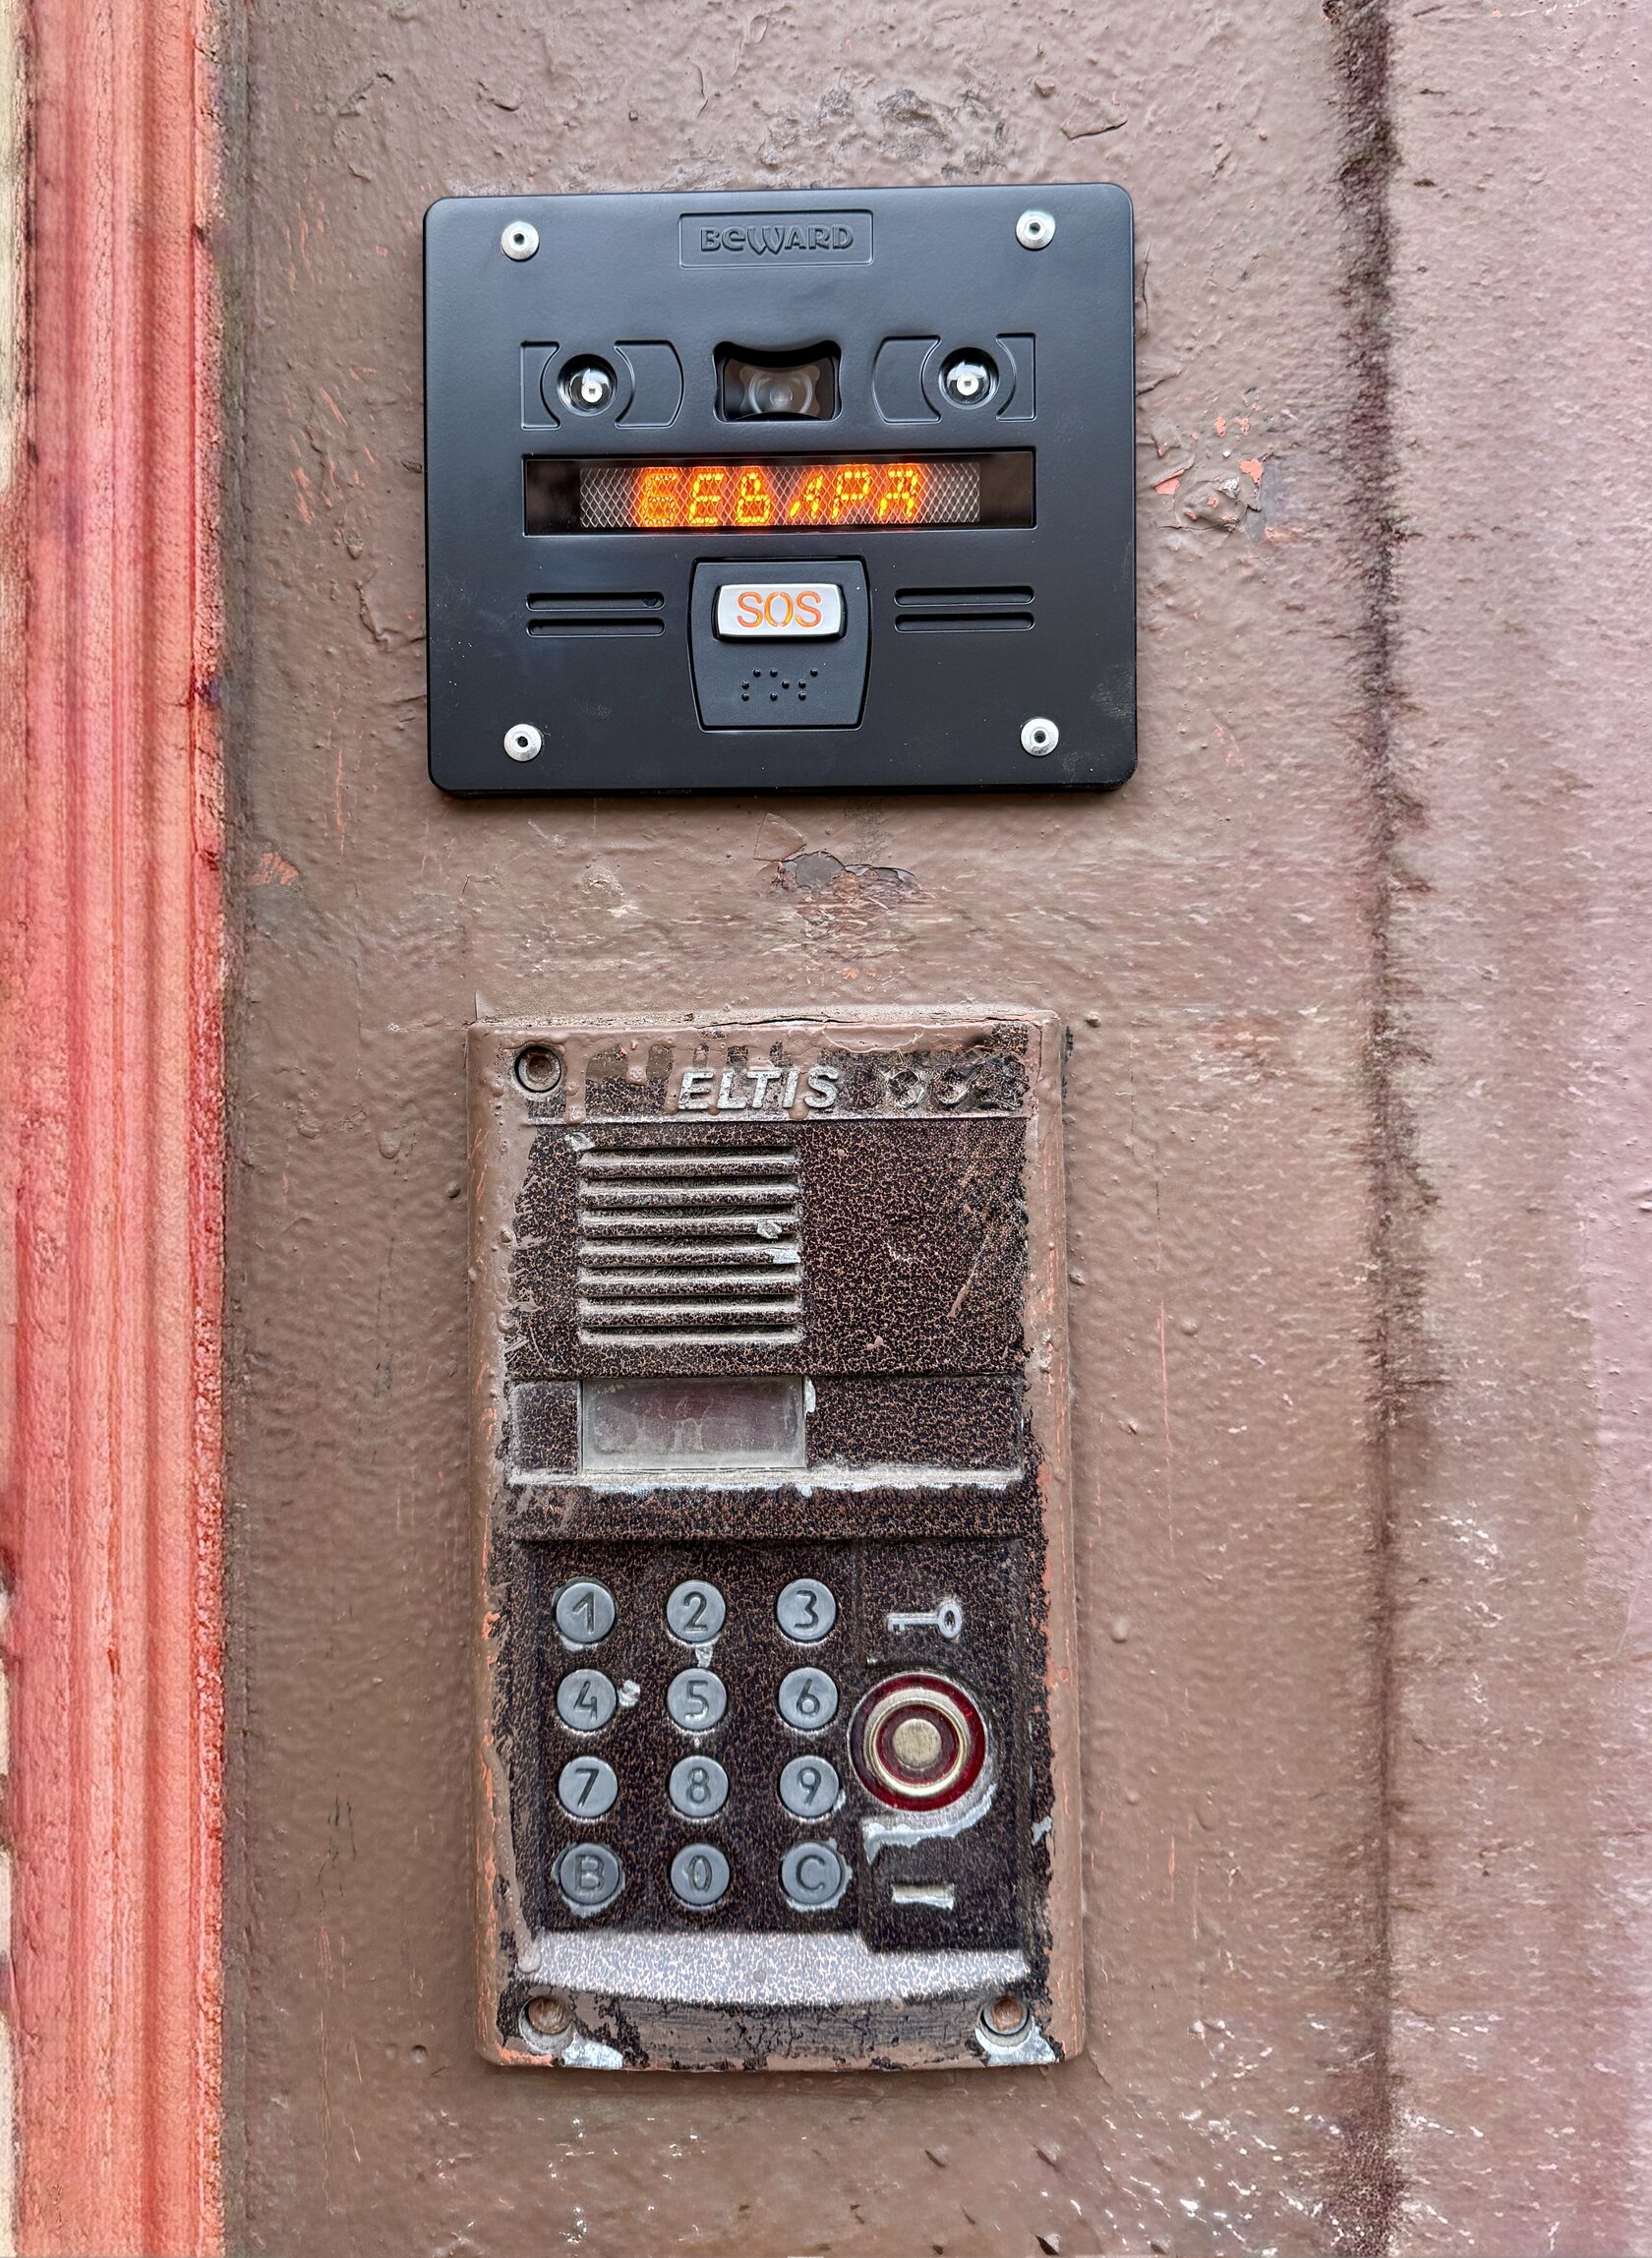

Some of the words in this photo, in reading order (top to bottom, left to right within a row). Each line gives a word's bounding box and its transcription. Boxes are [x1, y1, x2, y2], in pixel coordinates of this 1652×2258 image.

[737, 591, 822, 627] SOS
[678, 1066, 840, 1110] ELTIS
[572, 1591, 595, 1634] 1
[683, 1590, 708, 1633] 2
[795, 1589, 819, 1629] 3
[573, 1680, 598, 1721] 4
[685, 1680, 710, 1721] 5
[796, 1678, 821, 1716] 6
[575, 1768, 600, 1808] 7
[685, 1766, 711, 1804] 8
[797, 1766, 822, 1806] 9
[687, 1855, 713, 1892] 0
